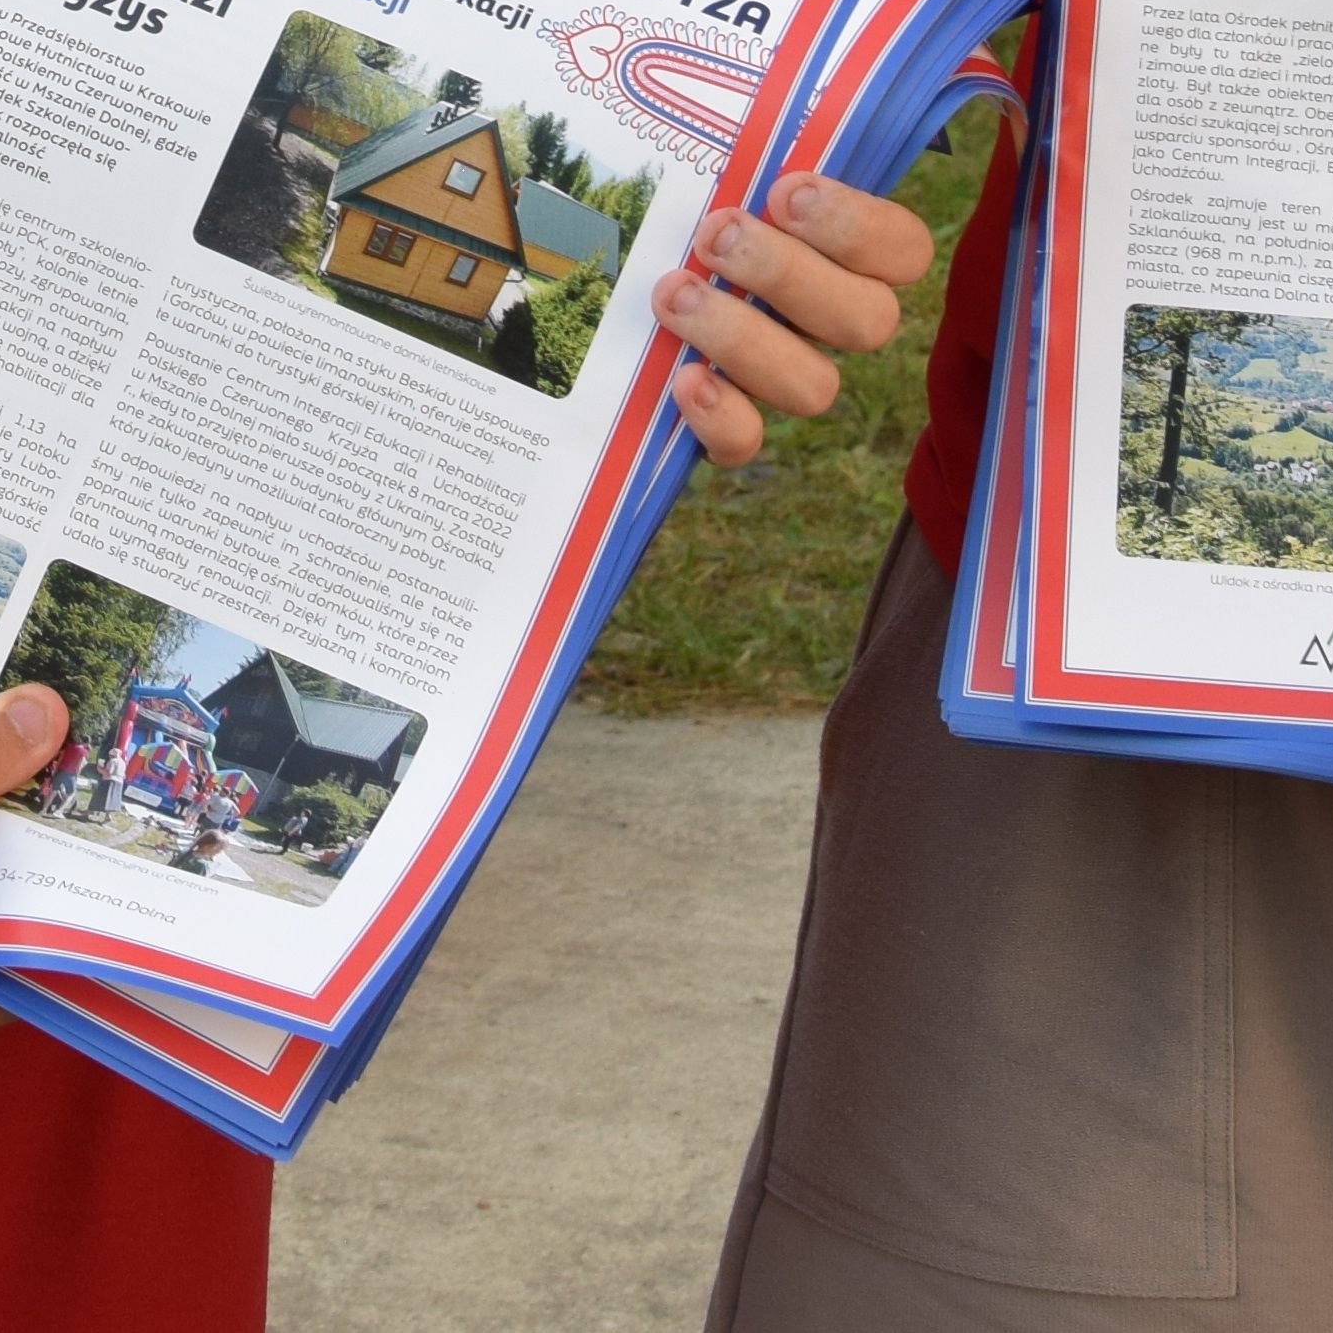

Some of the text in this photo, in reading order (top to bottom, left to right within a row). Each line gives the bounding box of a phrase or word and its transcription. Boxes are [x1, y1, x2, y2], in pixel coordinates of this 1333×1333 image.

[10, 12, 145, 76] Przedsiębiorstwo
[34, 42, 116, 86] Hutnictwa
[119, 80, 134, 92] w
[137, 85, 211, 125] Krakowie
[75, 80, 178, 132] Czerwonemu
[5, 115, 92, 159] rozpoczęła
[95, 153, 117, 172] się
[15, 77, 30, 90] w
[32, 82, 96, 118] Mszanie
[99, 110, 151, 144] Dolnej,
[154, 137, 197, 162] gdzie
[25, 100, 130, 151] Szkoleniowo-
[57, 880, 123, 908] Mszana
[126, 901, 176, 924] Dolna
